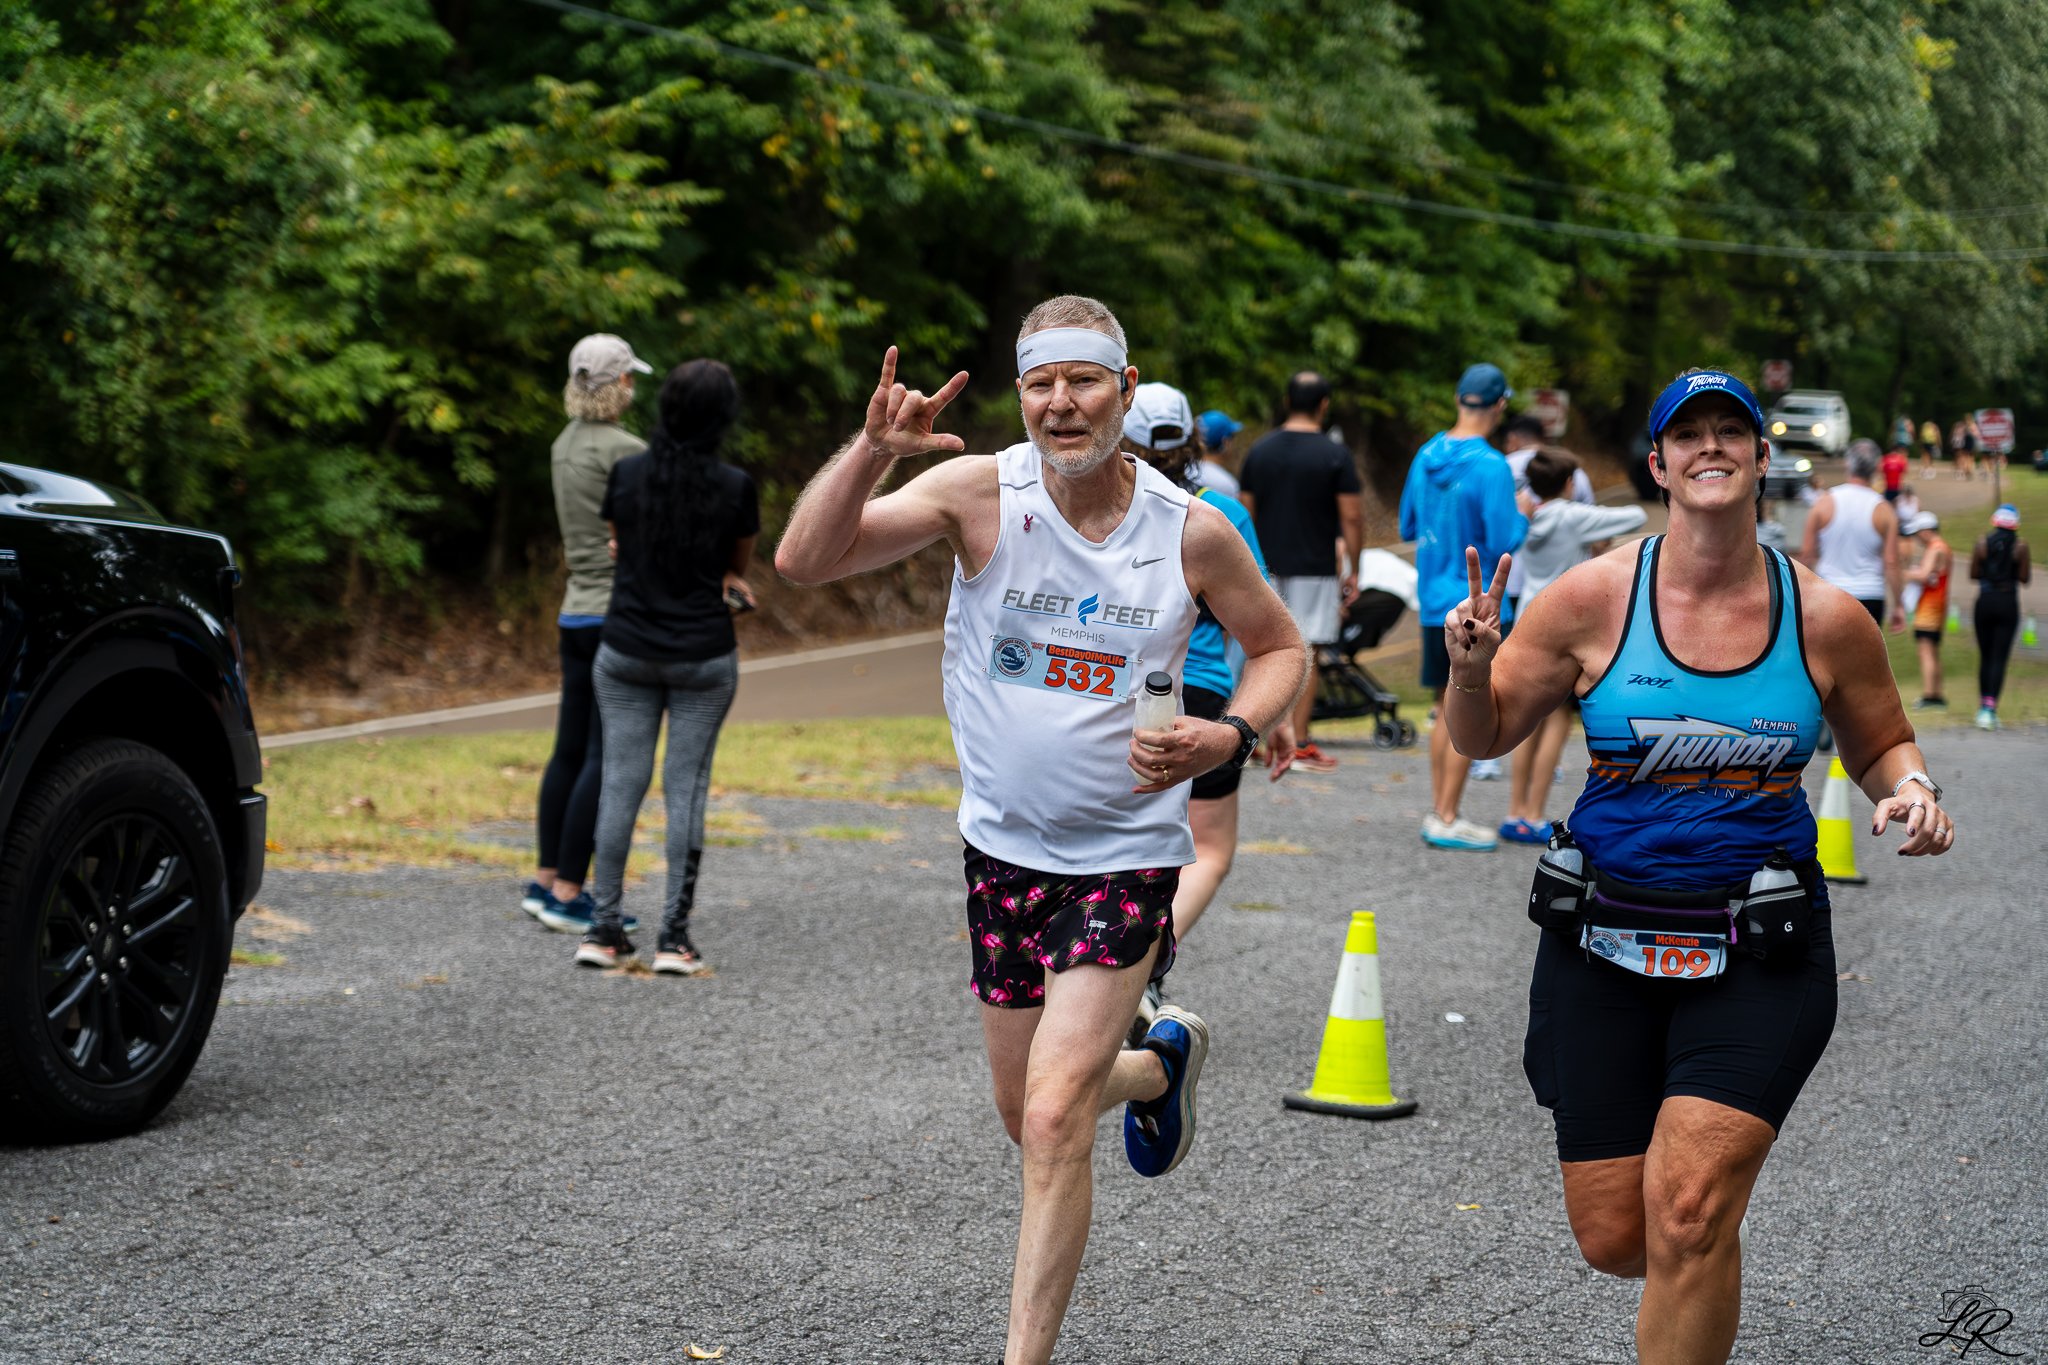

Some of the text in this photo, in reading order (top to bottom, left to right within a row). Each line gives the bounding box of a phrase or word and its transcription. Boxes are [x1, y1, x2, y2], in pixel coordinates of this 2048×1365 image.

[1686, 374, 1727, 393] THUNDER
[1002, 588, 1160, 627] FLEET FEET
[1051, 626, 1106, 644] MEMPHIS
[1048, 644, 1125, 667] BestDayOfMyLife
[1044, 657, 1116, 697] 532
[1750, 717, 1798, 732] MEMPHIS
[1628, 714, 1799, 784] THUNDER
[1655, 934, 1700, 947] McKenzie
[1642, 947, 1711, 977] 109
